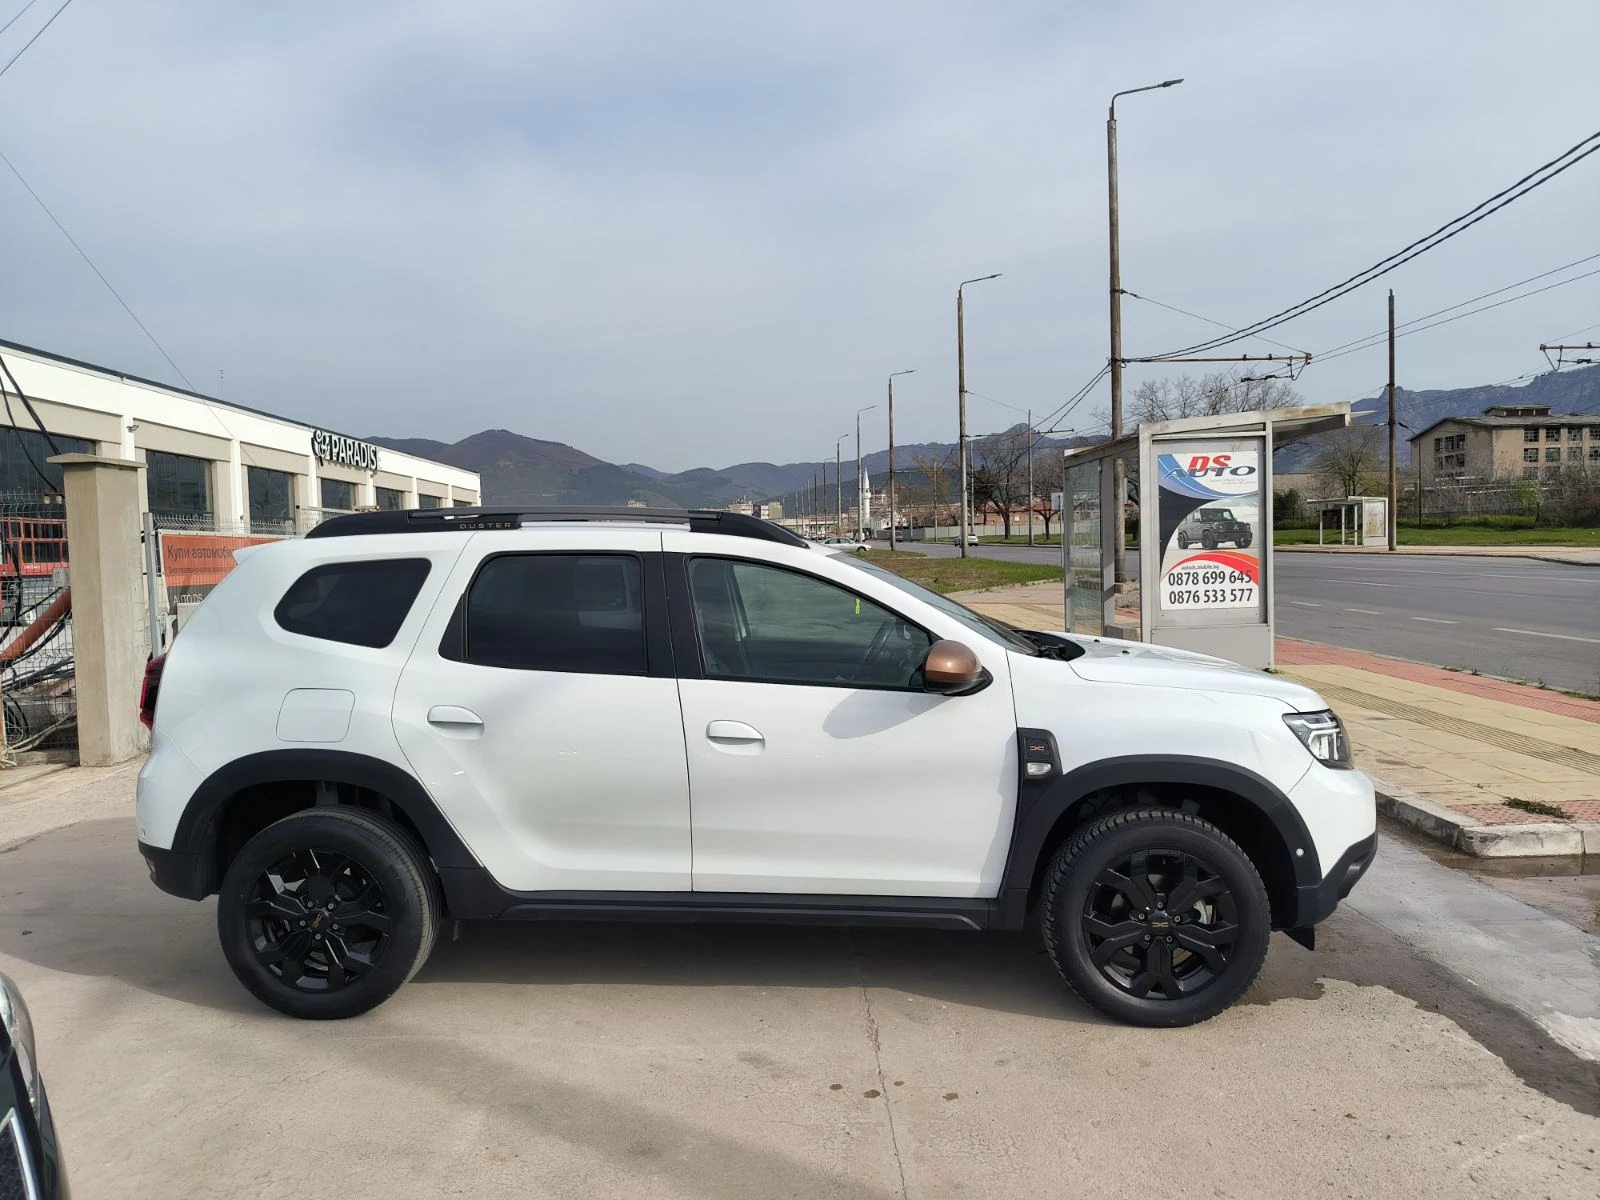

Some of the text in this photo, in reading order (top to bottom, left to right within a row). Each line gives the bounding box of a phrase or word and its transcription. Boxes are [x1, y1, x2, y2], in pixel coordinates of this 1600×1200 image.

[331, 435, 377, 470] PARADIS
[1163, 466, 1256, 478] AUTO
[1187, 455, 1231, 473] DS
[167, 545, 234, 561] Купи автомоби
[1168, 569, 1252, 586] 0878 699 645
[1169, 588, 1253, 605] 0876 533 577
